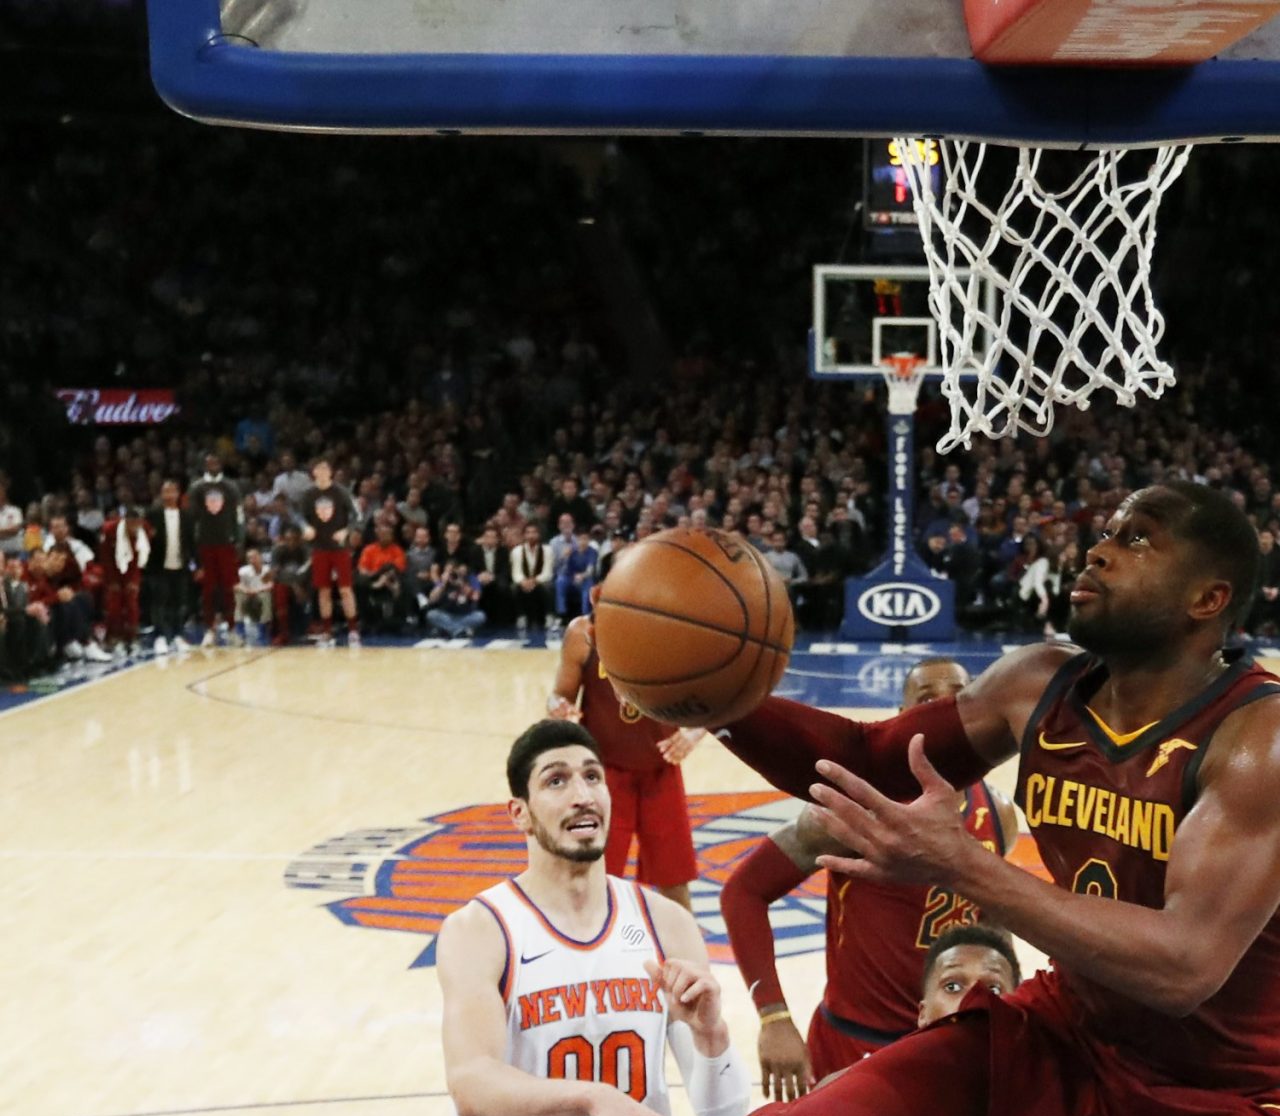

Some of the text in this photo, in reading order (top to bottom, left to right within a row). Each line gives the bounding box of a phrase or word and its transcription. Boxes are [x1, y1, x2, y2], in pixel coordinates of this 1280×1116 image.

[870, 592, 927, 617] KIA
[1025, 772, 1176, 862] CLEVELAND
[518, 977, 664, 1031] NEW YORK
[547, 1030, 647, 1104] 00
